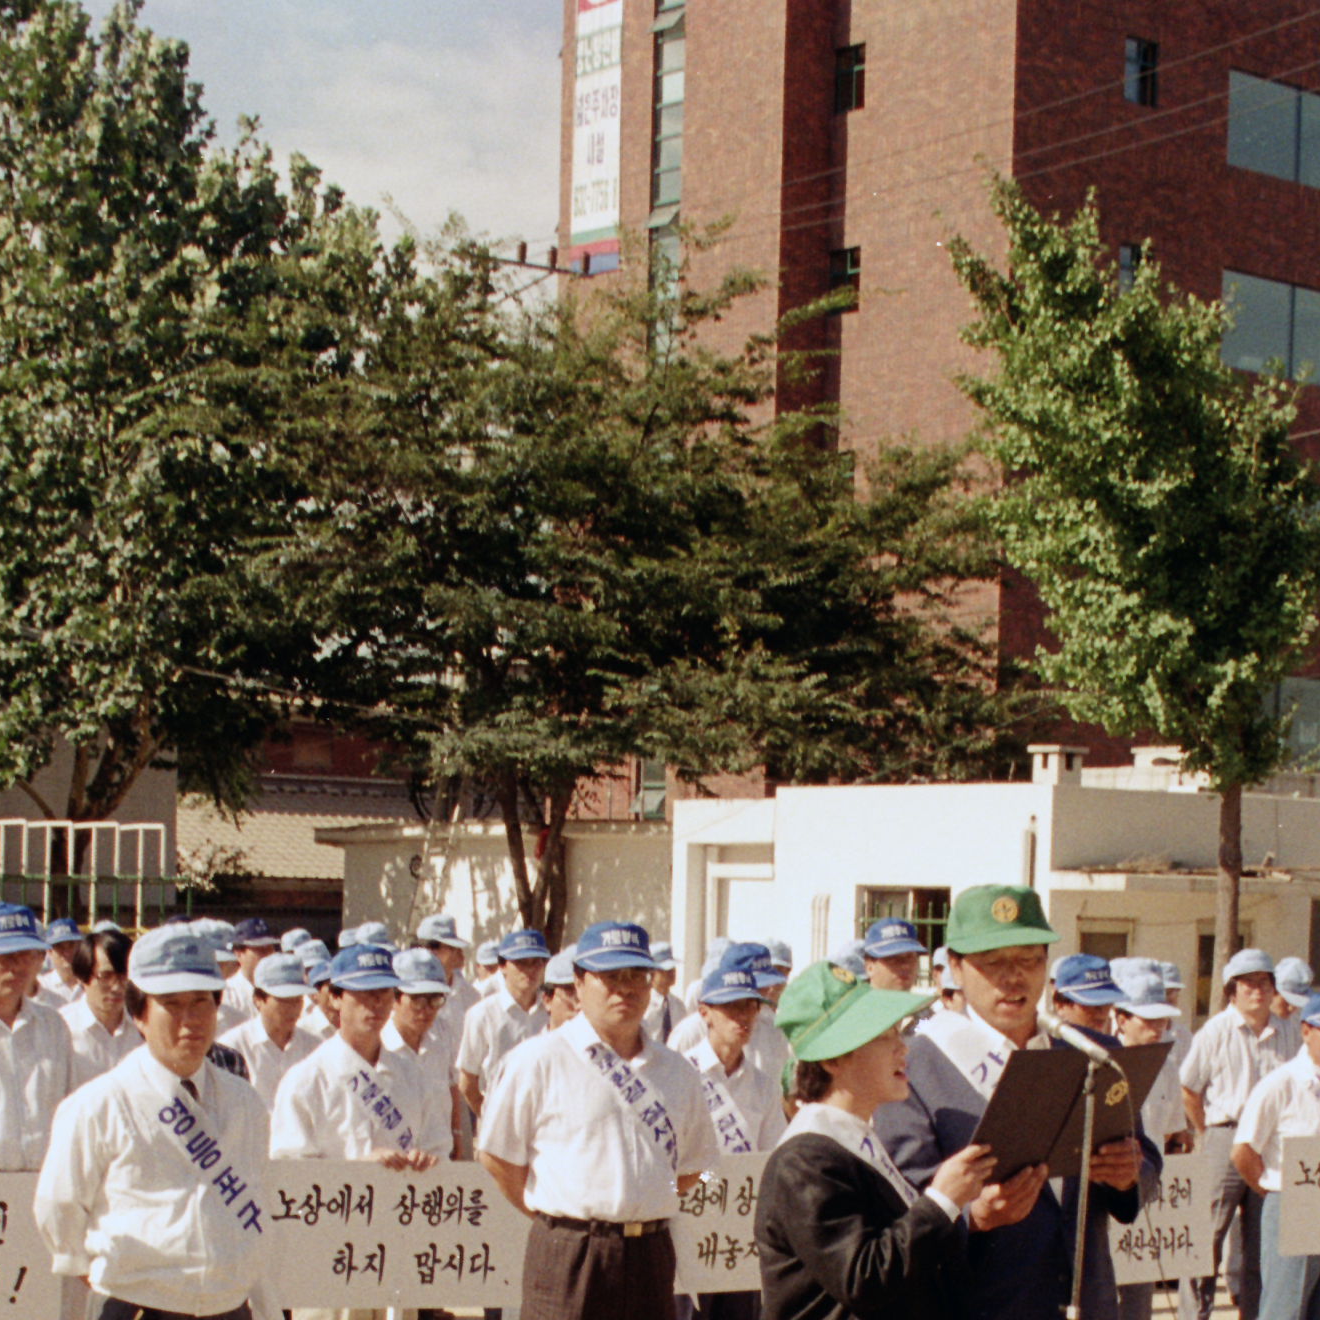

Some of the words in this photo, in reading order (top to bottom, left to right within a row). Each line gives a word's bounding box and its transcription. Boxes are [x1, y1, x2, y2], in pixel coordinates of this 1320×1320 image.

[158, 1096, 263, 1234] 영등포구
[271, 1183, 375, 1227] 노상에서
[392, 1183, 489, 1227] 상행위를
[332, 1241, 387, 1286] 하지
